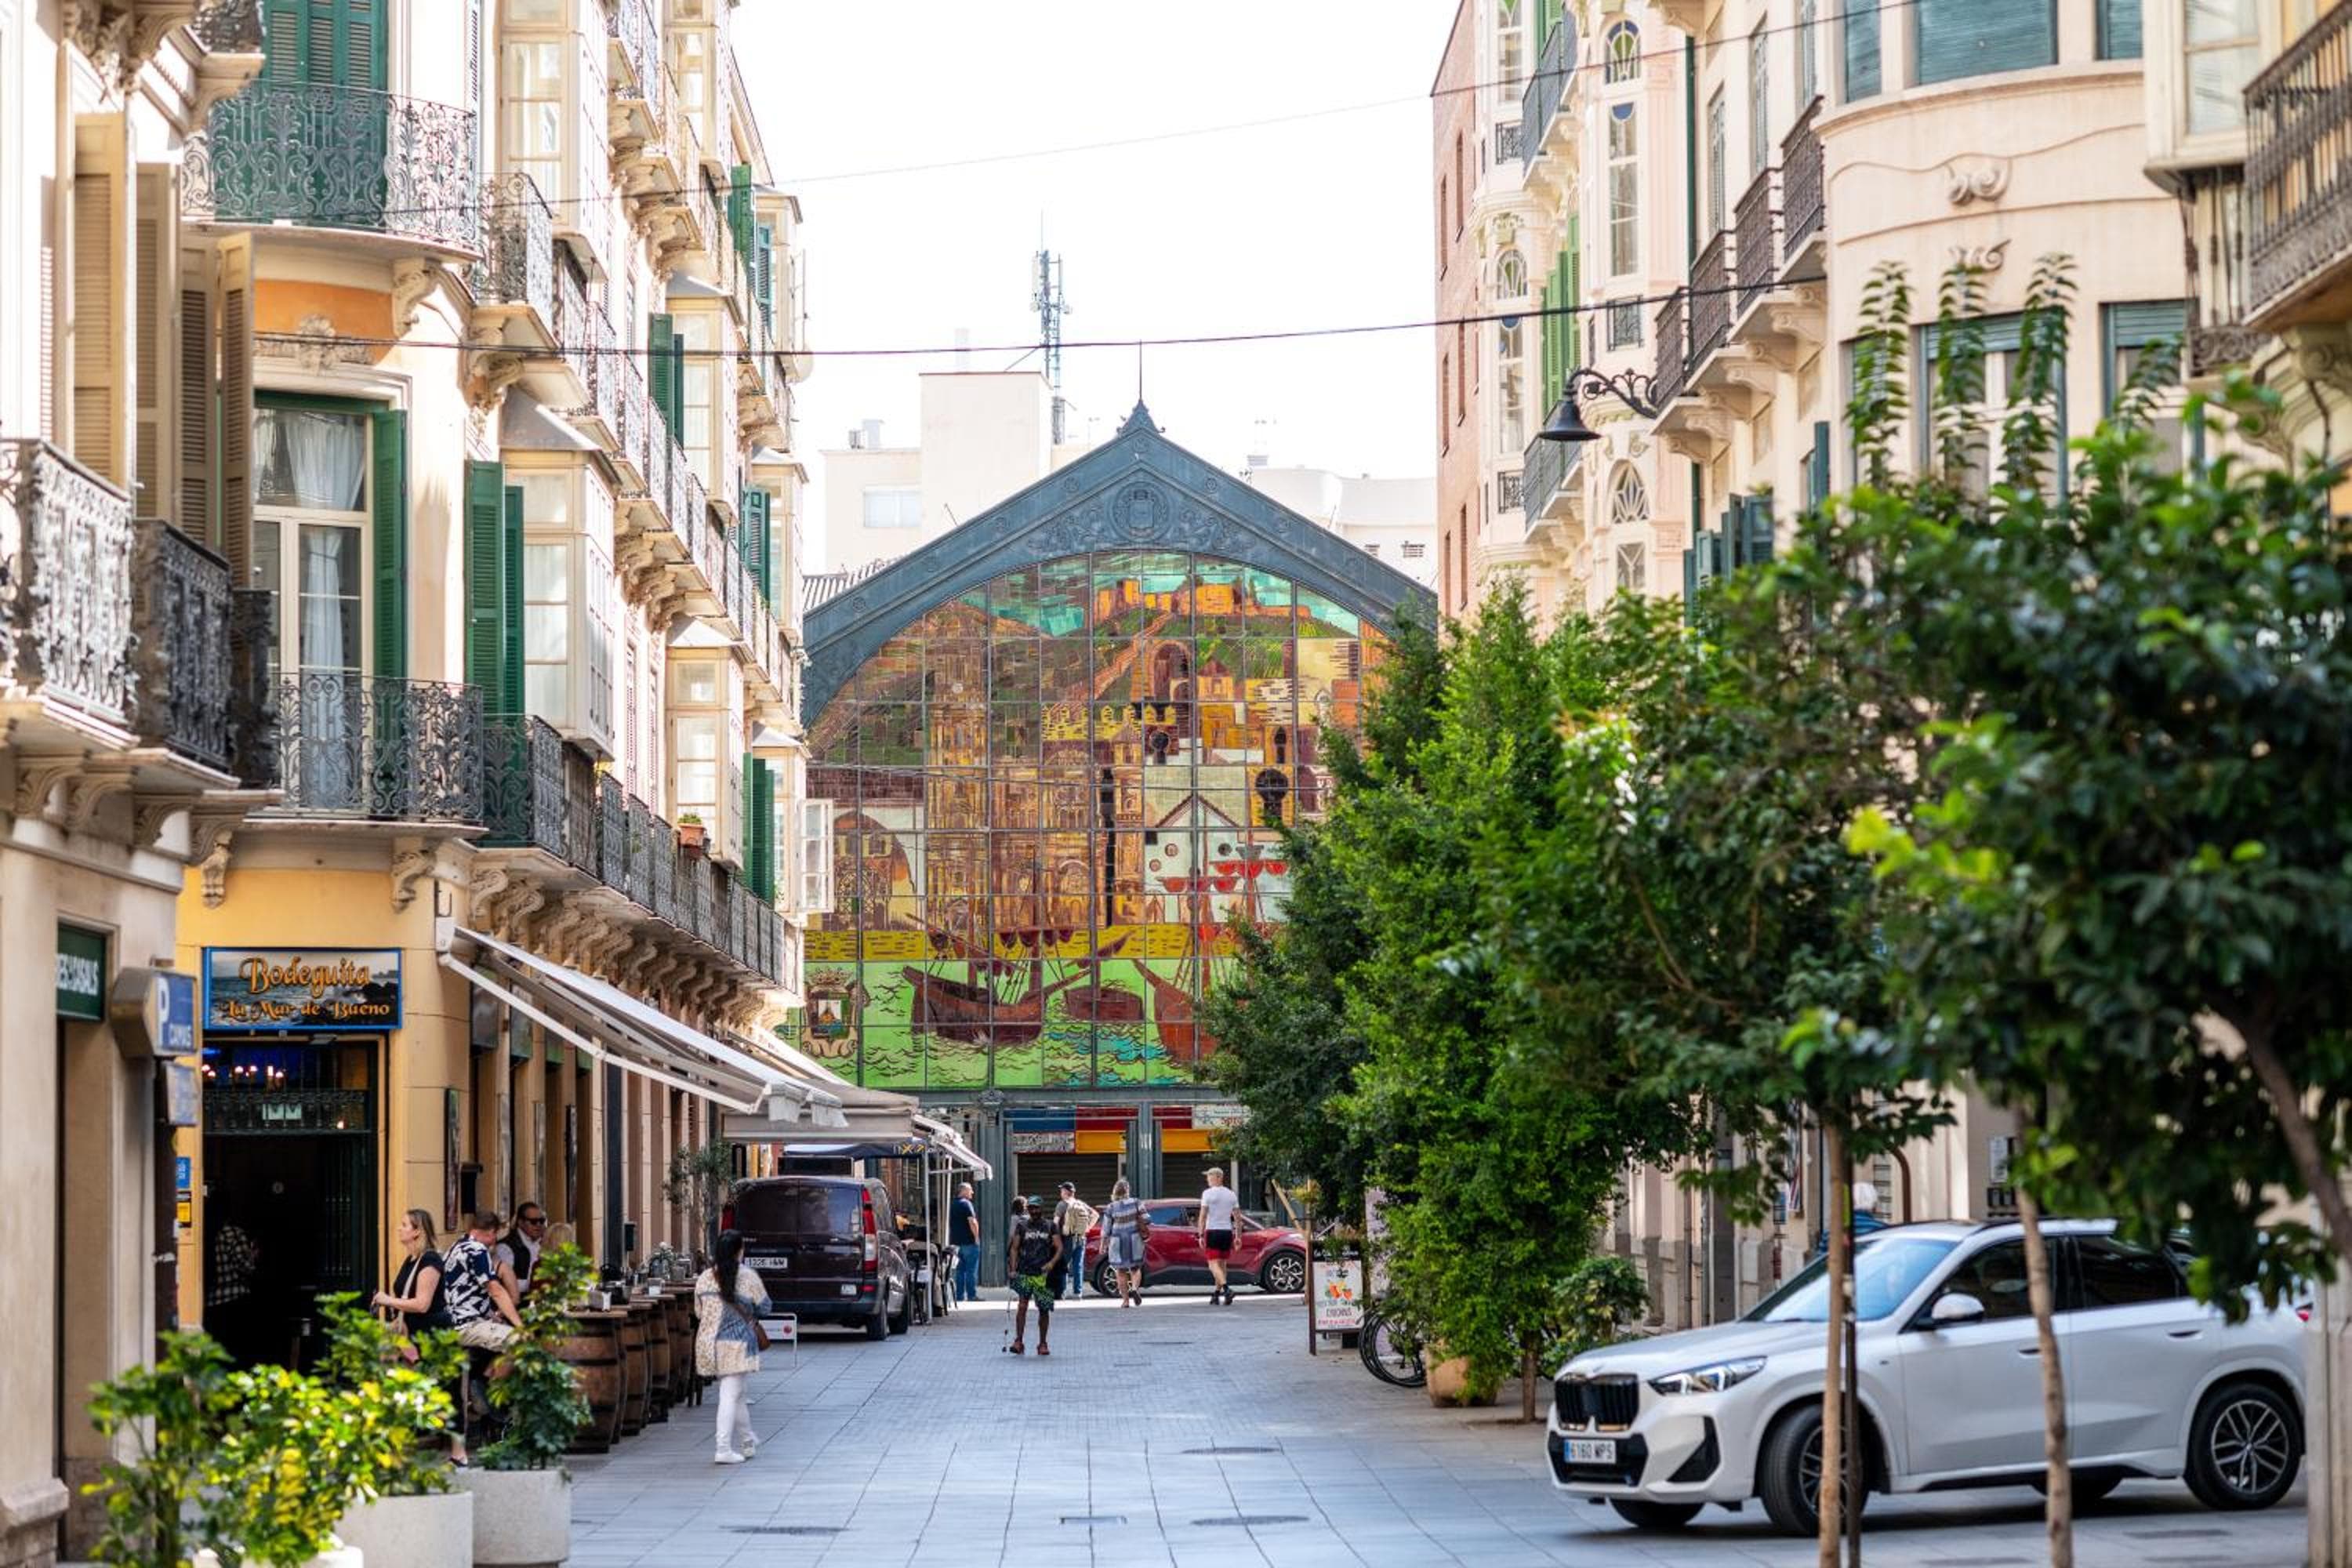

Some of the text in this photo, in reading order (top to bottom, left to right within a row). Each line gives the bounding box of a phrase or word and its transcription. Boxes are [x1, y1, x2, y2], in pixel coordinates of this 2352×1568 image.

[238, 956, 370, 999] Bodeguita
[158, 978, 170, 1050] P
[220, 1000, 390, 1020] La Mar de Bueno
